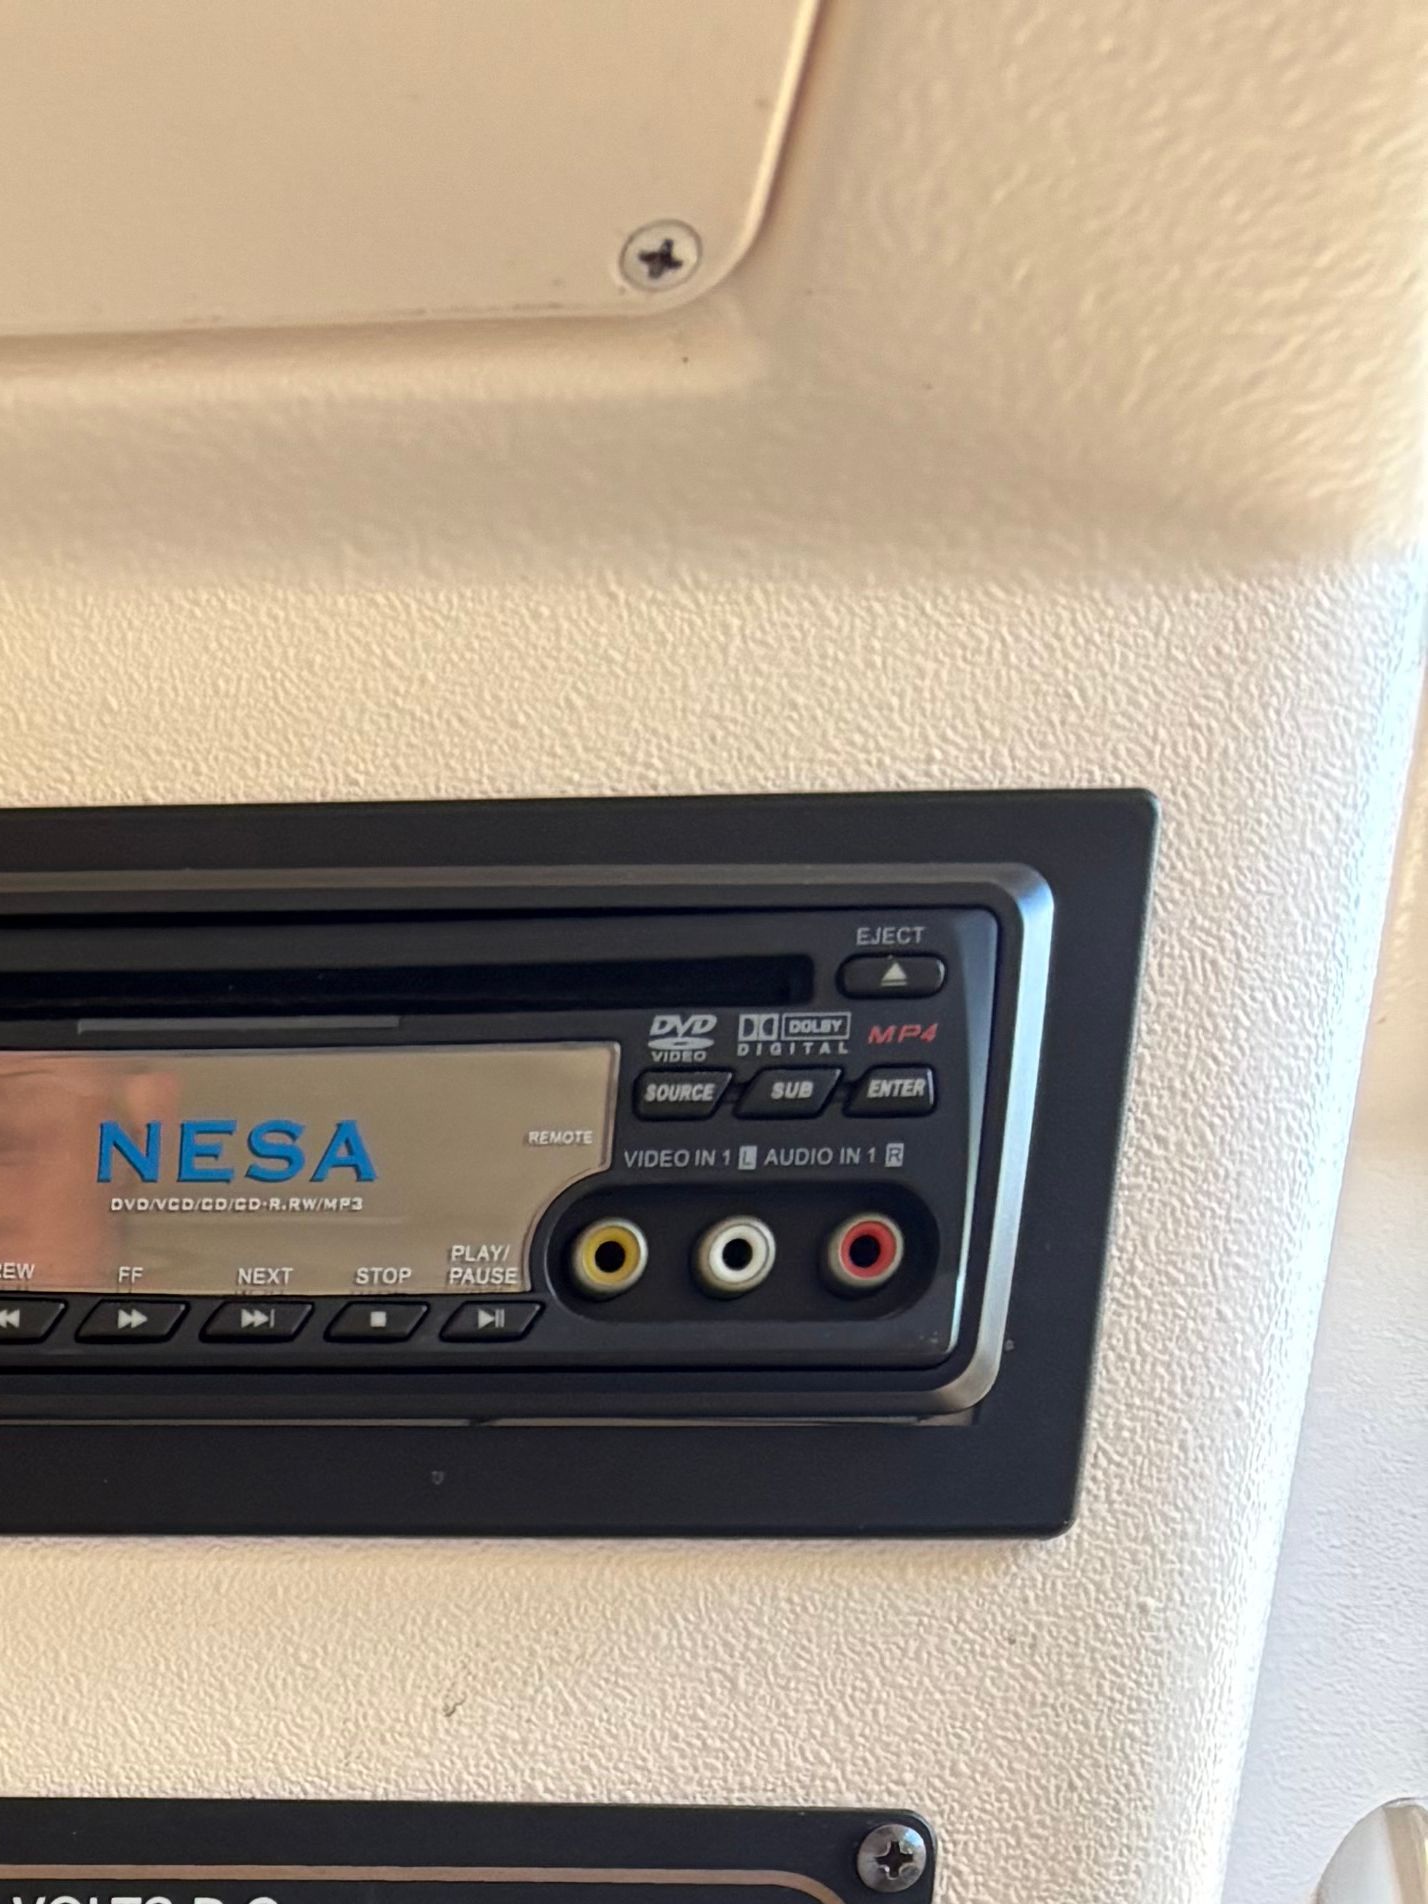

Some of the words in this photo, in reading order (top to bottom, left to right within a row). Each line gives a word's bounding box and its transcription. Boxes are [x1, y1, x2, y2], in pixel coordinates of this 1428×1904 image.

[857, 927, 925, 945] EJECT
[650, 1015, 717, 1039] DVD
[789, 1019, 843, 1033] DOLBY
[868, 1023, 938, 1043] MP4
[652, 1047, 706, 1062] VIDEO
[738, 1042, 848, 1056] DIGITAL
[646, 1083, 715, 1101] SOURCE
[771, 1081, 813, 1099] SUB
[868, 1078, 926, 1097] ENTER
[529, 1131, 592, 1144] REMOTE
[97, 1120, 376, 1183] NESA
[624, 1150, 689, 1167] VIDEO
[695, 1150, 716, 1165] IN
[723, 1149, 730, 1165] 1
[764, 1148, 833, 1165] AUDIO
[840, 1148, 860, 1164] IN
[868, 1147, 875, 1162] 1
[448, 1245, 510, 1263] PLAY/
[0, 1262, 35, 1280] REW
[119, 1267, 143, 1282] FF
[239, 1268, 293, 1285] NEXT
[357, 1267, 411, 1285] STOP
[450, 1267, 518, 1285] PAUSE
